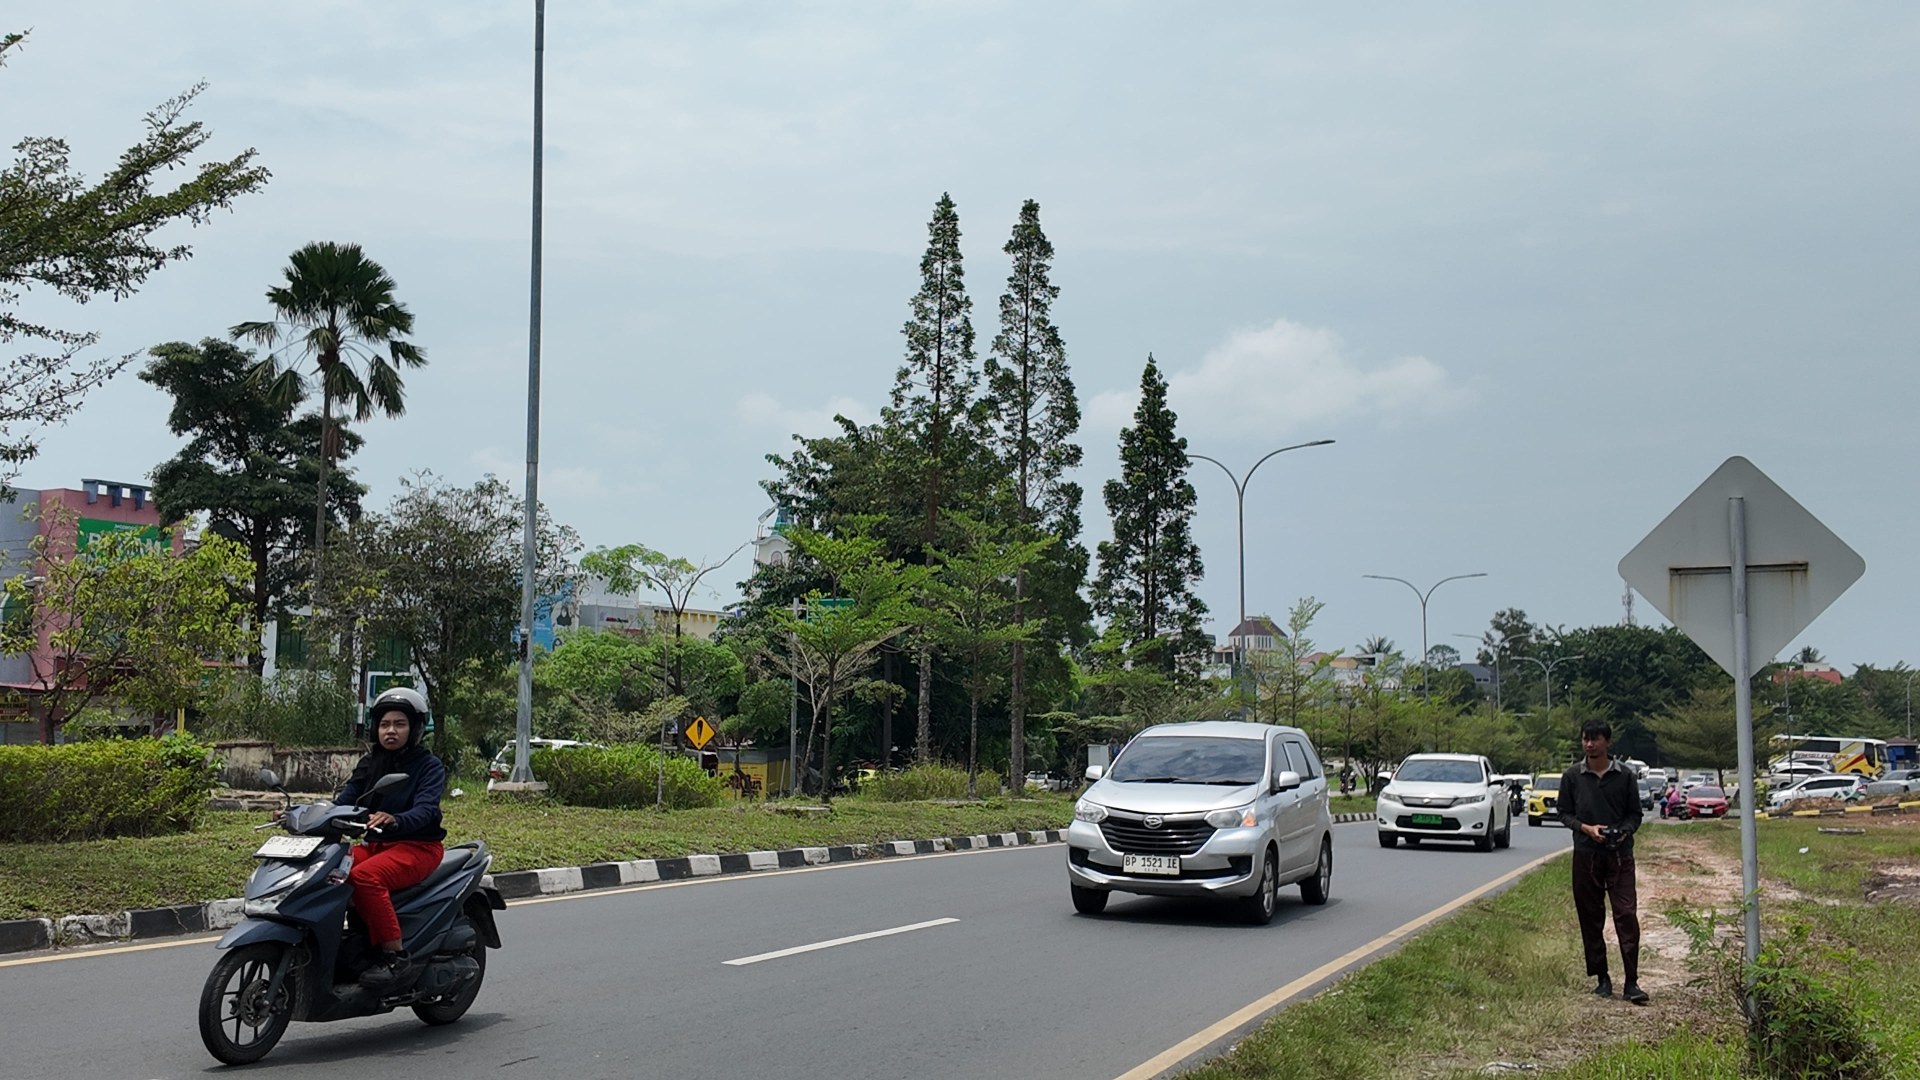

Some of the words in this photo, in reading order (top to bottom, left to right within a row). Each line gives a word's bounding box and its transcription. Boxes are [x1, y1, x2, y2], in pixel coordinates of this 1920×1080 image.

[1125, 856, 1137, 867] BP
[1141, 857, 1163, 868] 1521
[1167, 858, 1178, 869] IE
